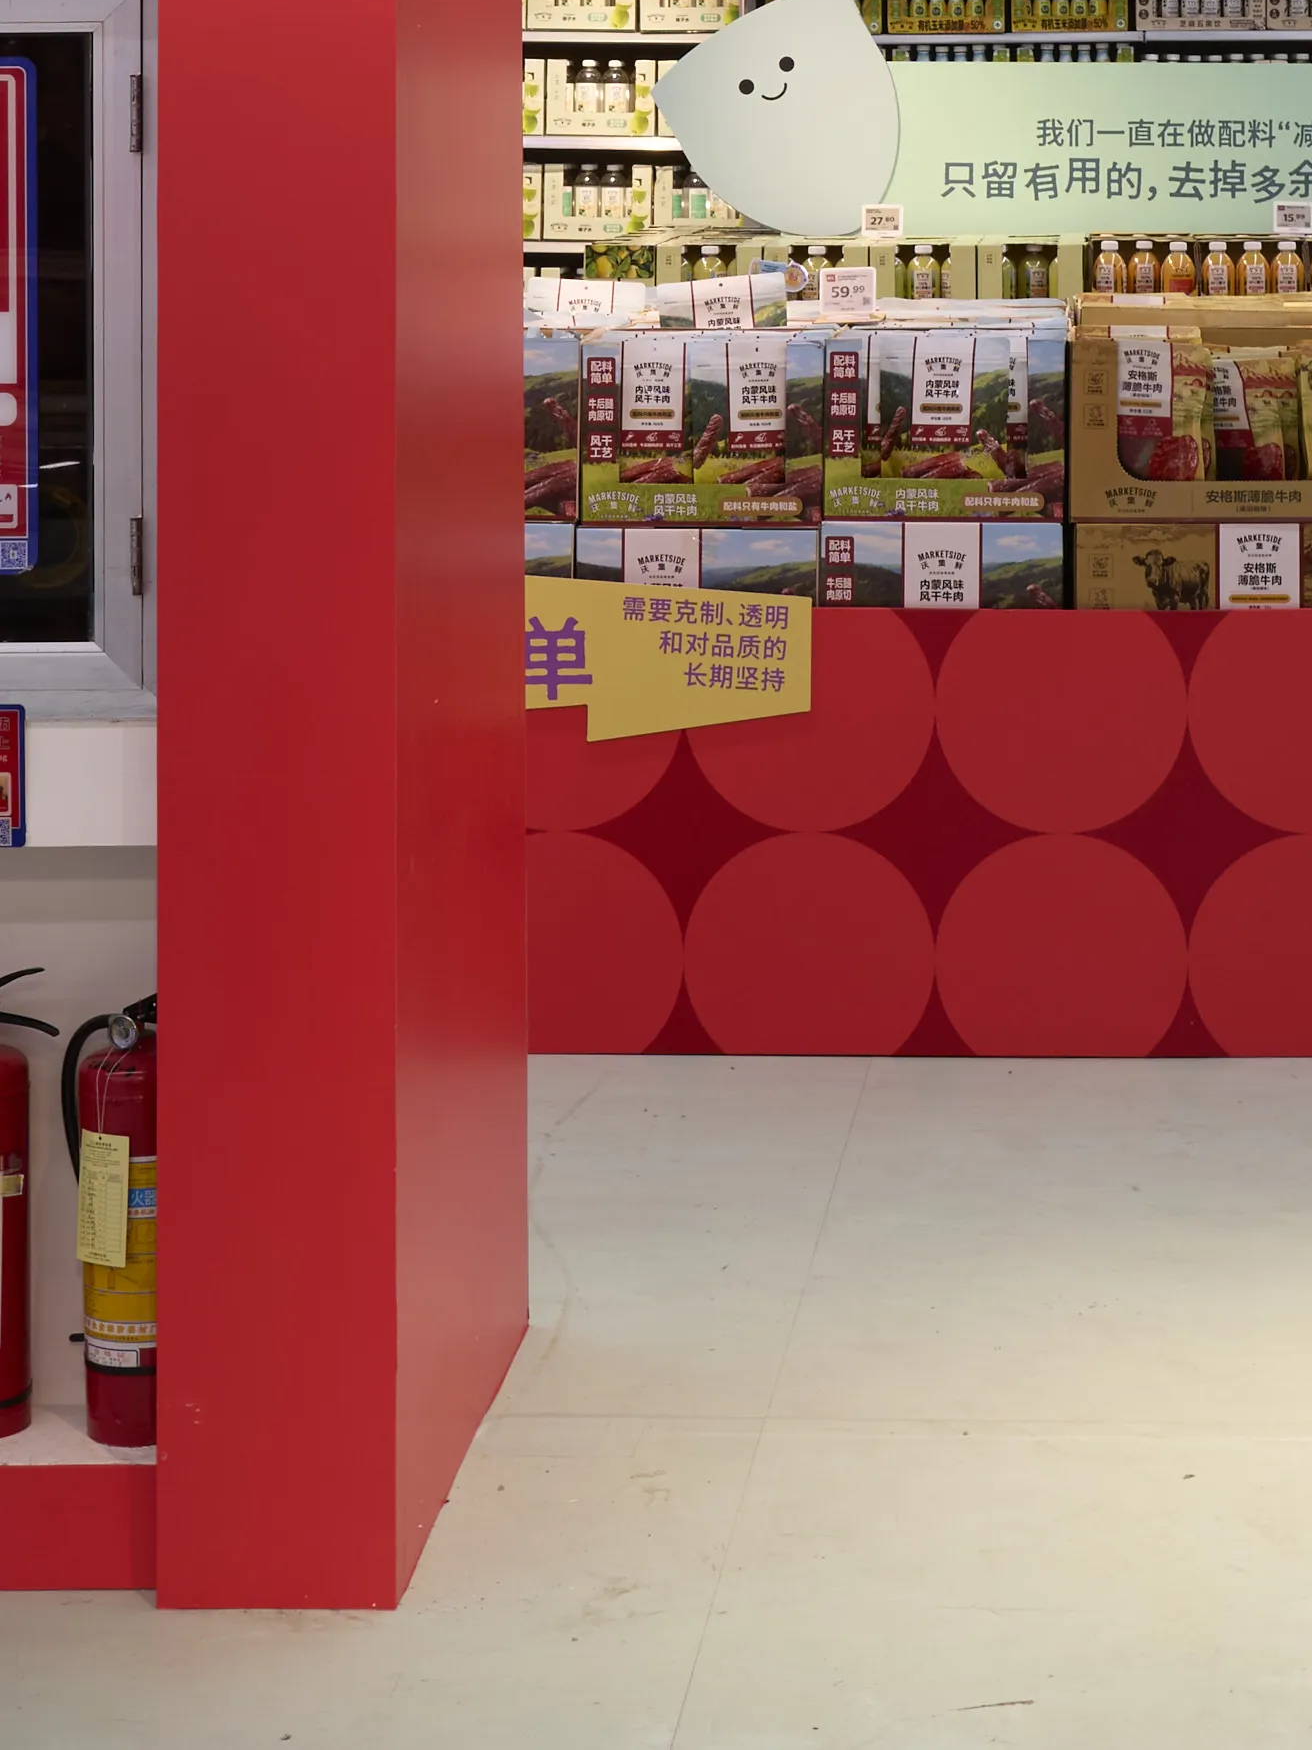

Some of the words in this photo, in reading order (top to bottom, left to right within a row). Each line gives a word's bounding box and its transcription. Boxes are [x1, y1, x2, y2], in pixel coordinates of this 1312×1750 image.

[831, 285, 866, 299] 59.99
[1128, 370, 1158, 382] 安格斯
[634, 394, 671, 404] 风干牛肉
[742, 395, 777, 404] 风干牛肉
[590, 435, 613, 446] 风干
[832, 429, 855, 441] 风干
[590, 447, 613, 458] 工艺
[832, 441, 855, 453] 工艺
[829, 485, 881, 498] MARKETSIDE
[895, 489, 939, 500] 内蒙风味
[1105, 487, 1157, 499] MARKETSIDE
[1206, 490, 1302, 503] 安格斯薄脆牛肉
[588, 491, 640, 505] MARKETSIDE
[653, 493, 697, 504] 内蒙风味
[964, 496, 1039, 508] 配料只有牛肉和盐
[653, 505, 697, 517] 风干牛肉
[723, 501, 798, 512] 配料只有牛肉和盐
[895, 500, 939, 512] 风干牛肉
[829, 540, 852, 551] 配料
[1236, 533, 1282, 547] MARKETSIDE
[637, 554, 686, 566] MARKETSIDE
[828, 552, 851, 563] 简单
[917, 550, 967, 562] MARKETSIDE
[1243, 562, 1277, 574] 安格斯
[920, 579, 965, 590] 内蒙风味
[1238, 574, 1282, 586] 薄脆牛肉
[826, 590, 852, 601] 肉原切
[919, 591, 964, 602] 风干牛肉
[622, 596, 789, 630] 需要克制、透明
[659, 630, 788, 661] 和对品质的
[684, 662, 786, 692] 长期坚持
